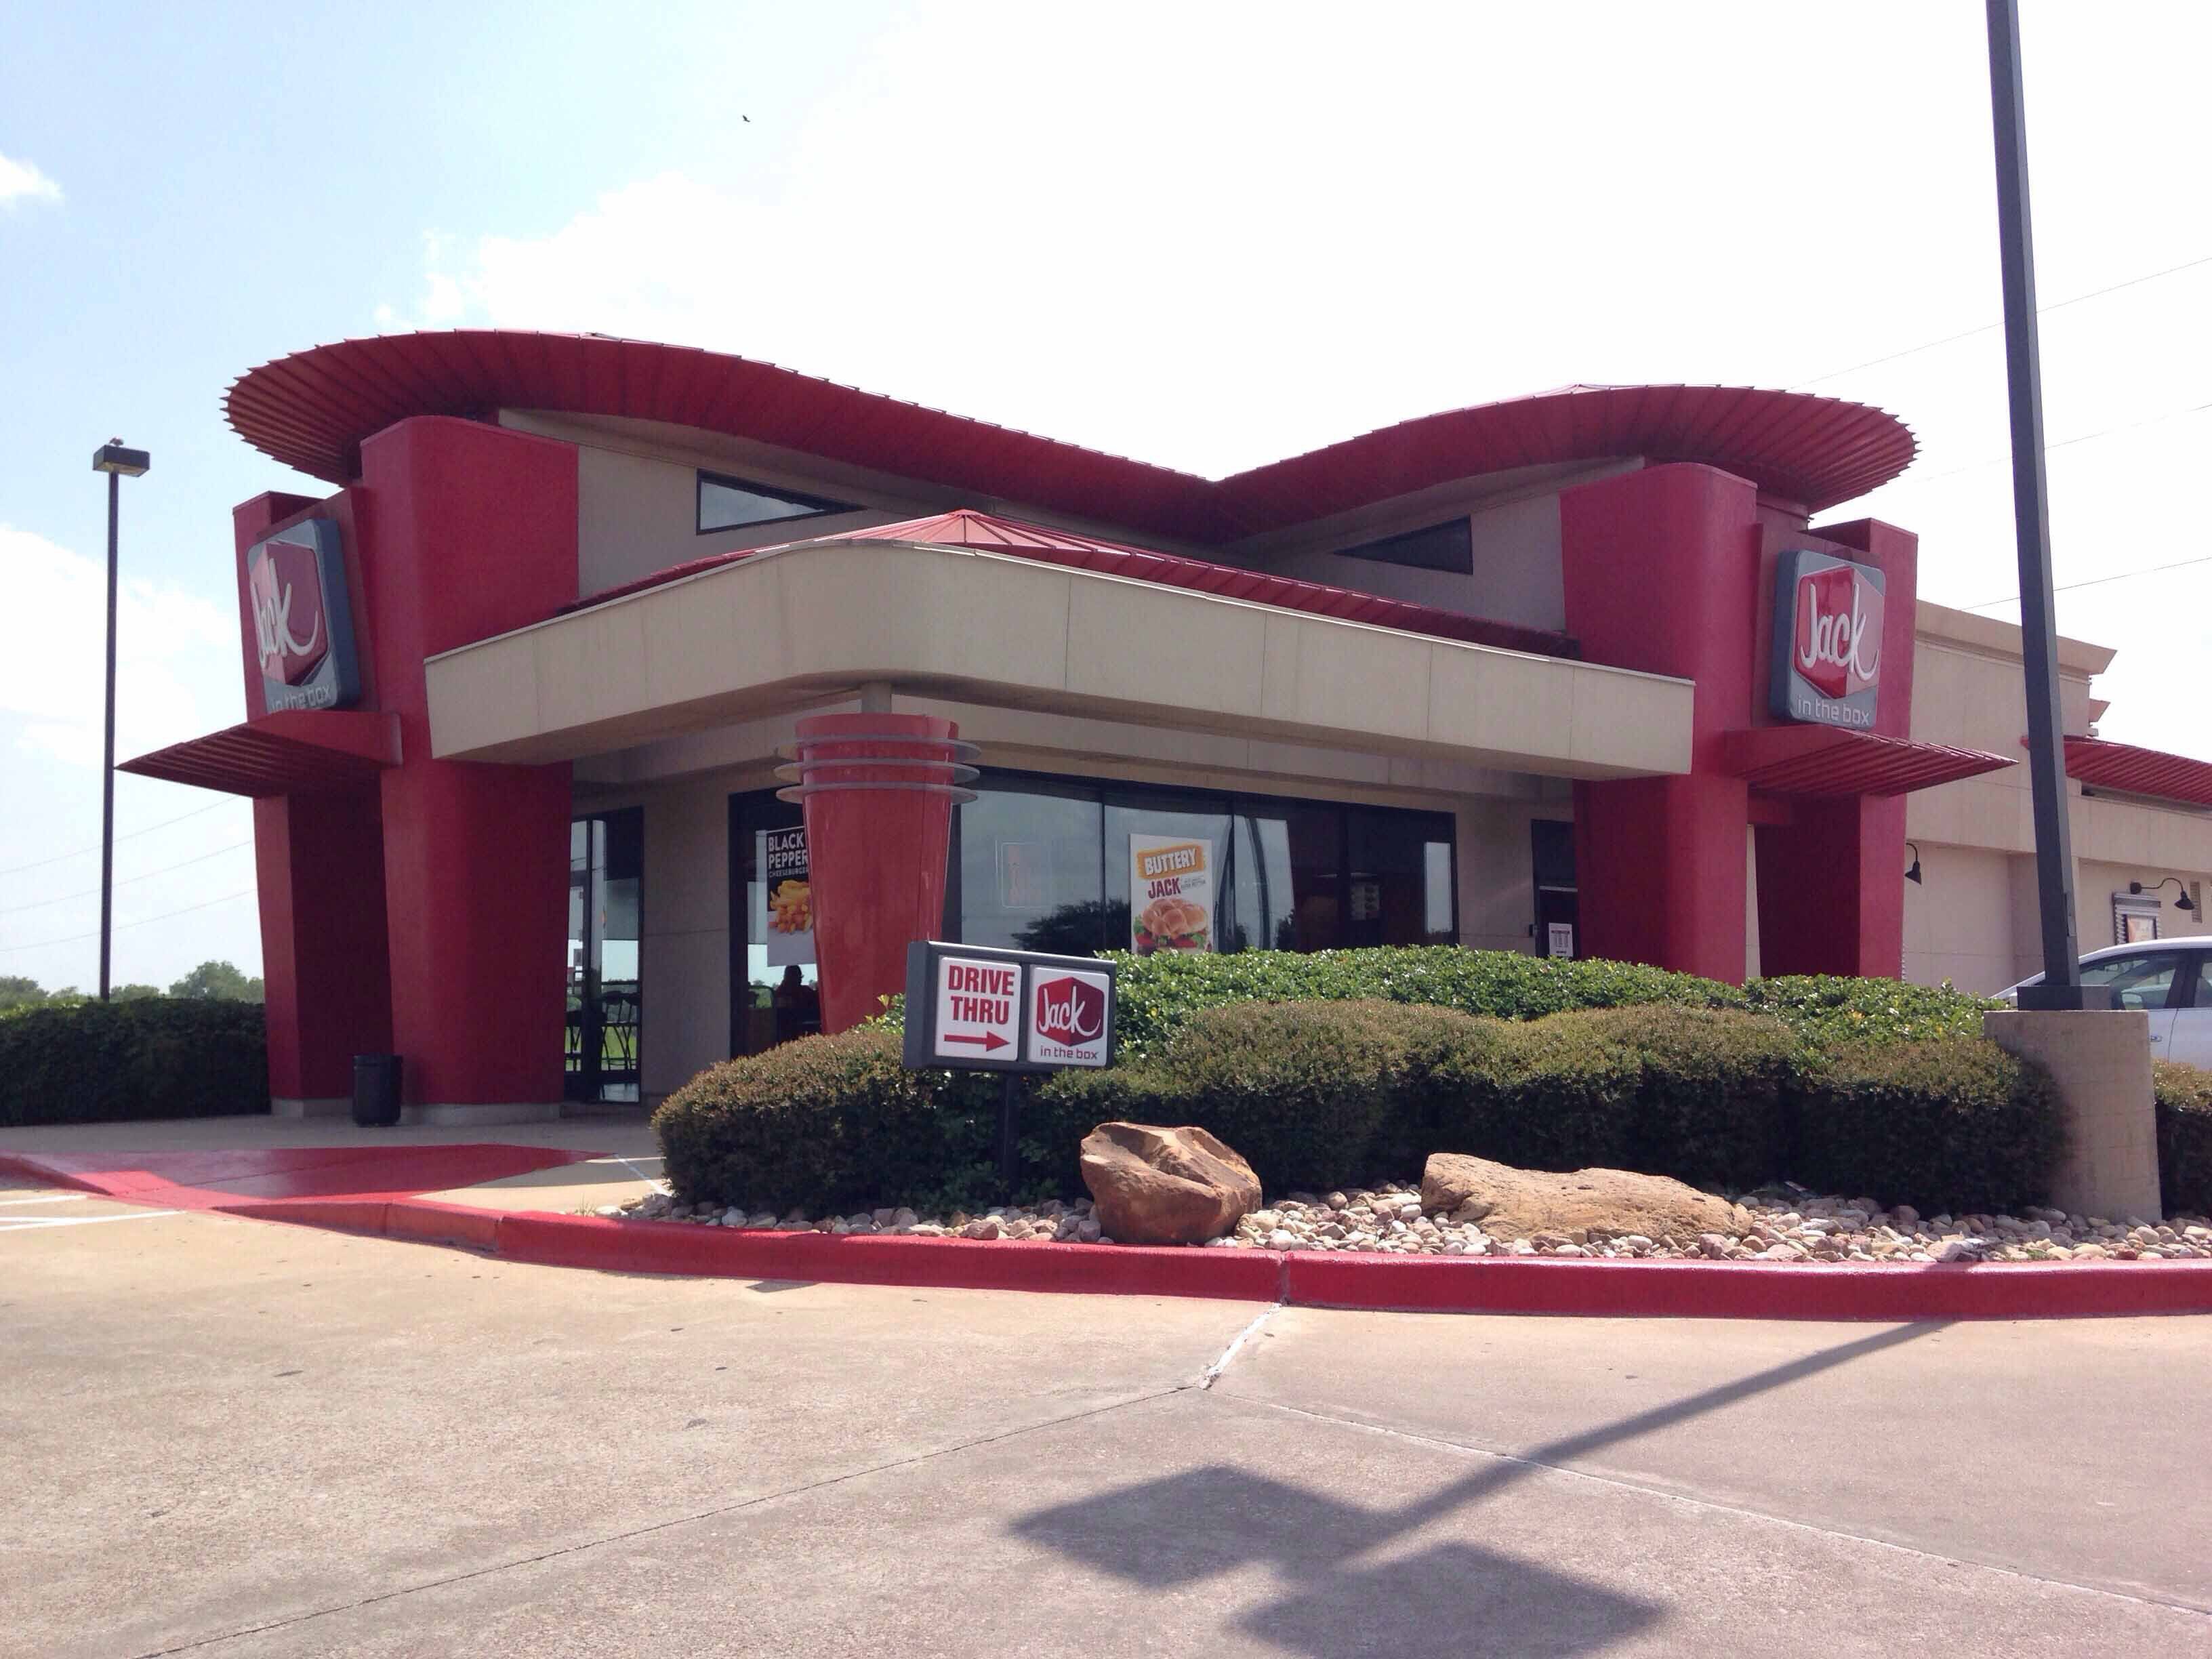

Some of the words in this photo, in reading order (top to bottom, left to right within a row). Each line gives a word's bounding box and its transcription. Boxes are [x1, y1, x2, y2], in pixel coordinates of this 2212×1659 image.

[251, 558, 319, 670] Jack
[1800, 583, 1880, 681] Jack
[285, 693, 307, 710] the
[307, 684, 331, 707] box
[1797, 695, 1811, 716] in
[1816, 697, 1839, 721] the
[1843, 703, 1871, 726] box
[769, 832, 804, 852] BLACK
[769, 848, 808, 869] PEPPER
[1144, 848, 1197, 876] BUTTERY
[1148, 878, 1181, 899] JACK
[948, 964, 1015, 996] DRIVE
[951, 996, 1010, 1025] THRU
[1038, 985, 1101, 1036] Jack
[1040, 1045, 1051, 1057] in
[1054, 1046, 1074, 1059] the
[1076, 1048, 1099, 1060] box
